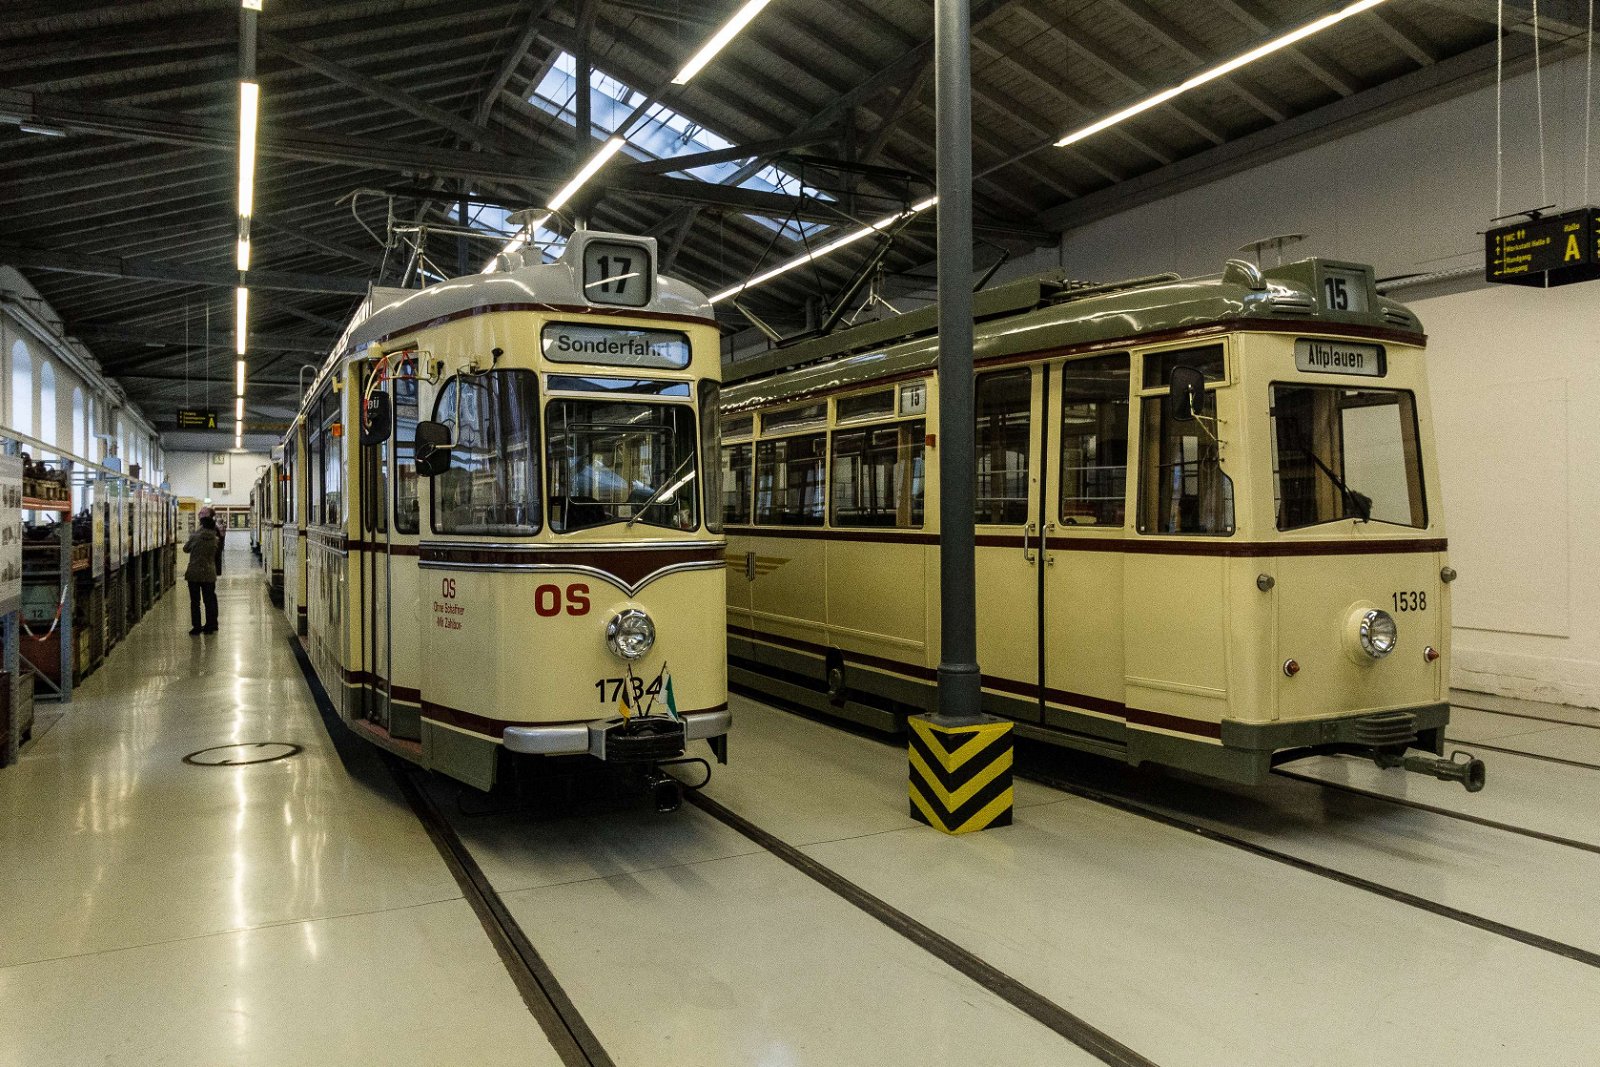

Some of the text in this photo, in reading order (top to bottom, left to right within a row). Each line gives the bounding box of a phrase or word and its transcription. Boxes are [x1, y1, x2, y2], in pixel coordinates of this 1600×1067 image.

[1564, 234, 1581, 262] A
[597, 255, 632, 294] 17
[1324, 277, 1348, 310] 15
[557, 335, 672, 357] Sonderfahrt
[1308, 344, 1364, 369] Altplauen
[911, 386, 920, 407] 15
[208, 417, 216, 428] A
[442, 577, 456, 599] OS
[534, 583, 591, 617] OS
[1392, 591, 1427, 613] 1538
[32, 609, 44, 618] 12
[595, 675, 663, 703] 1734
